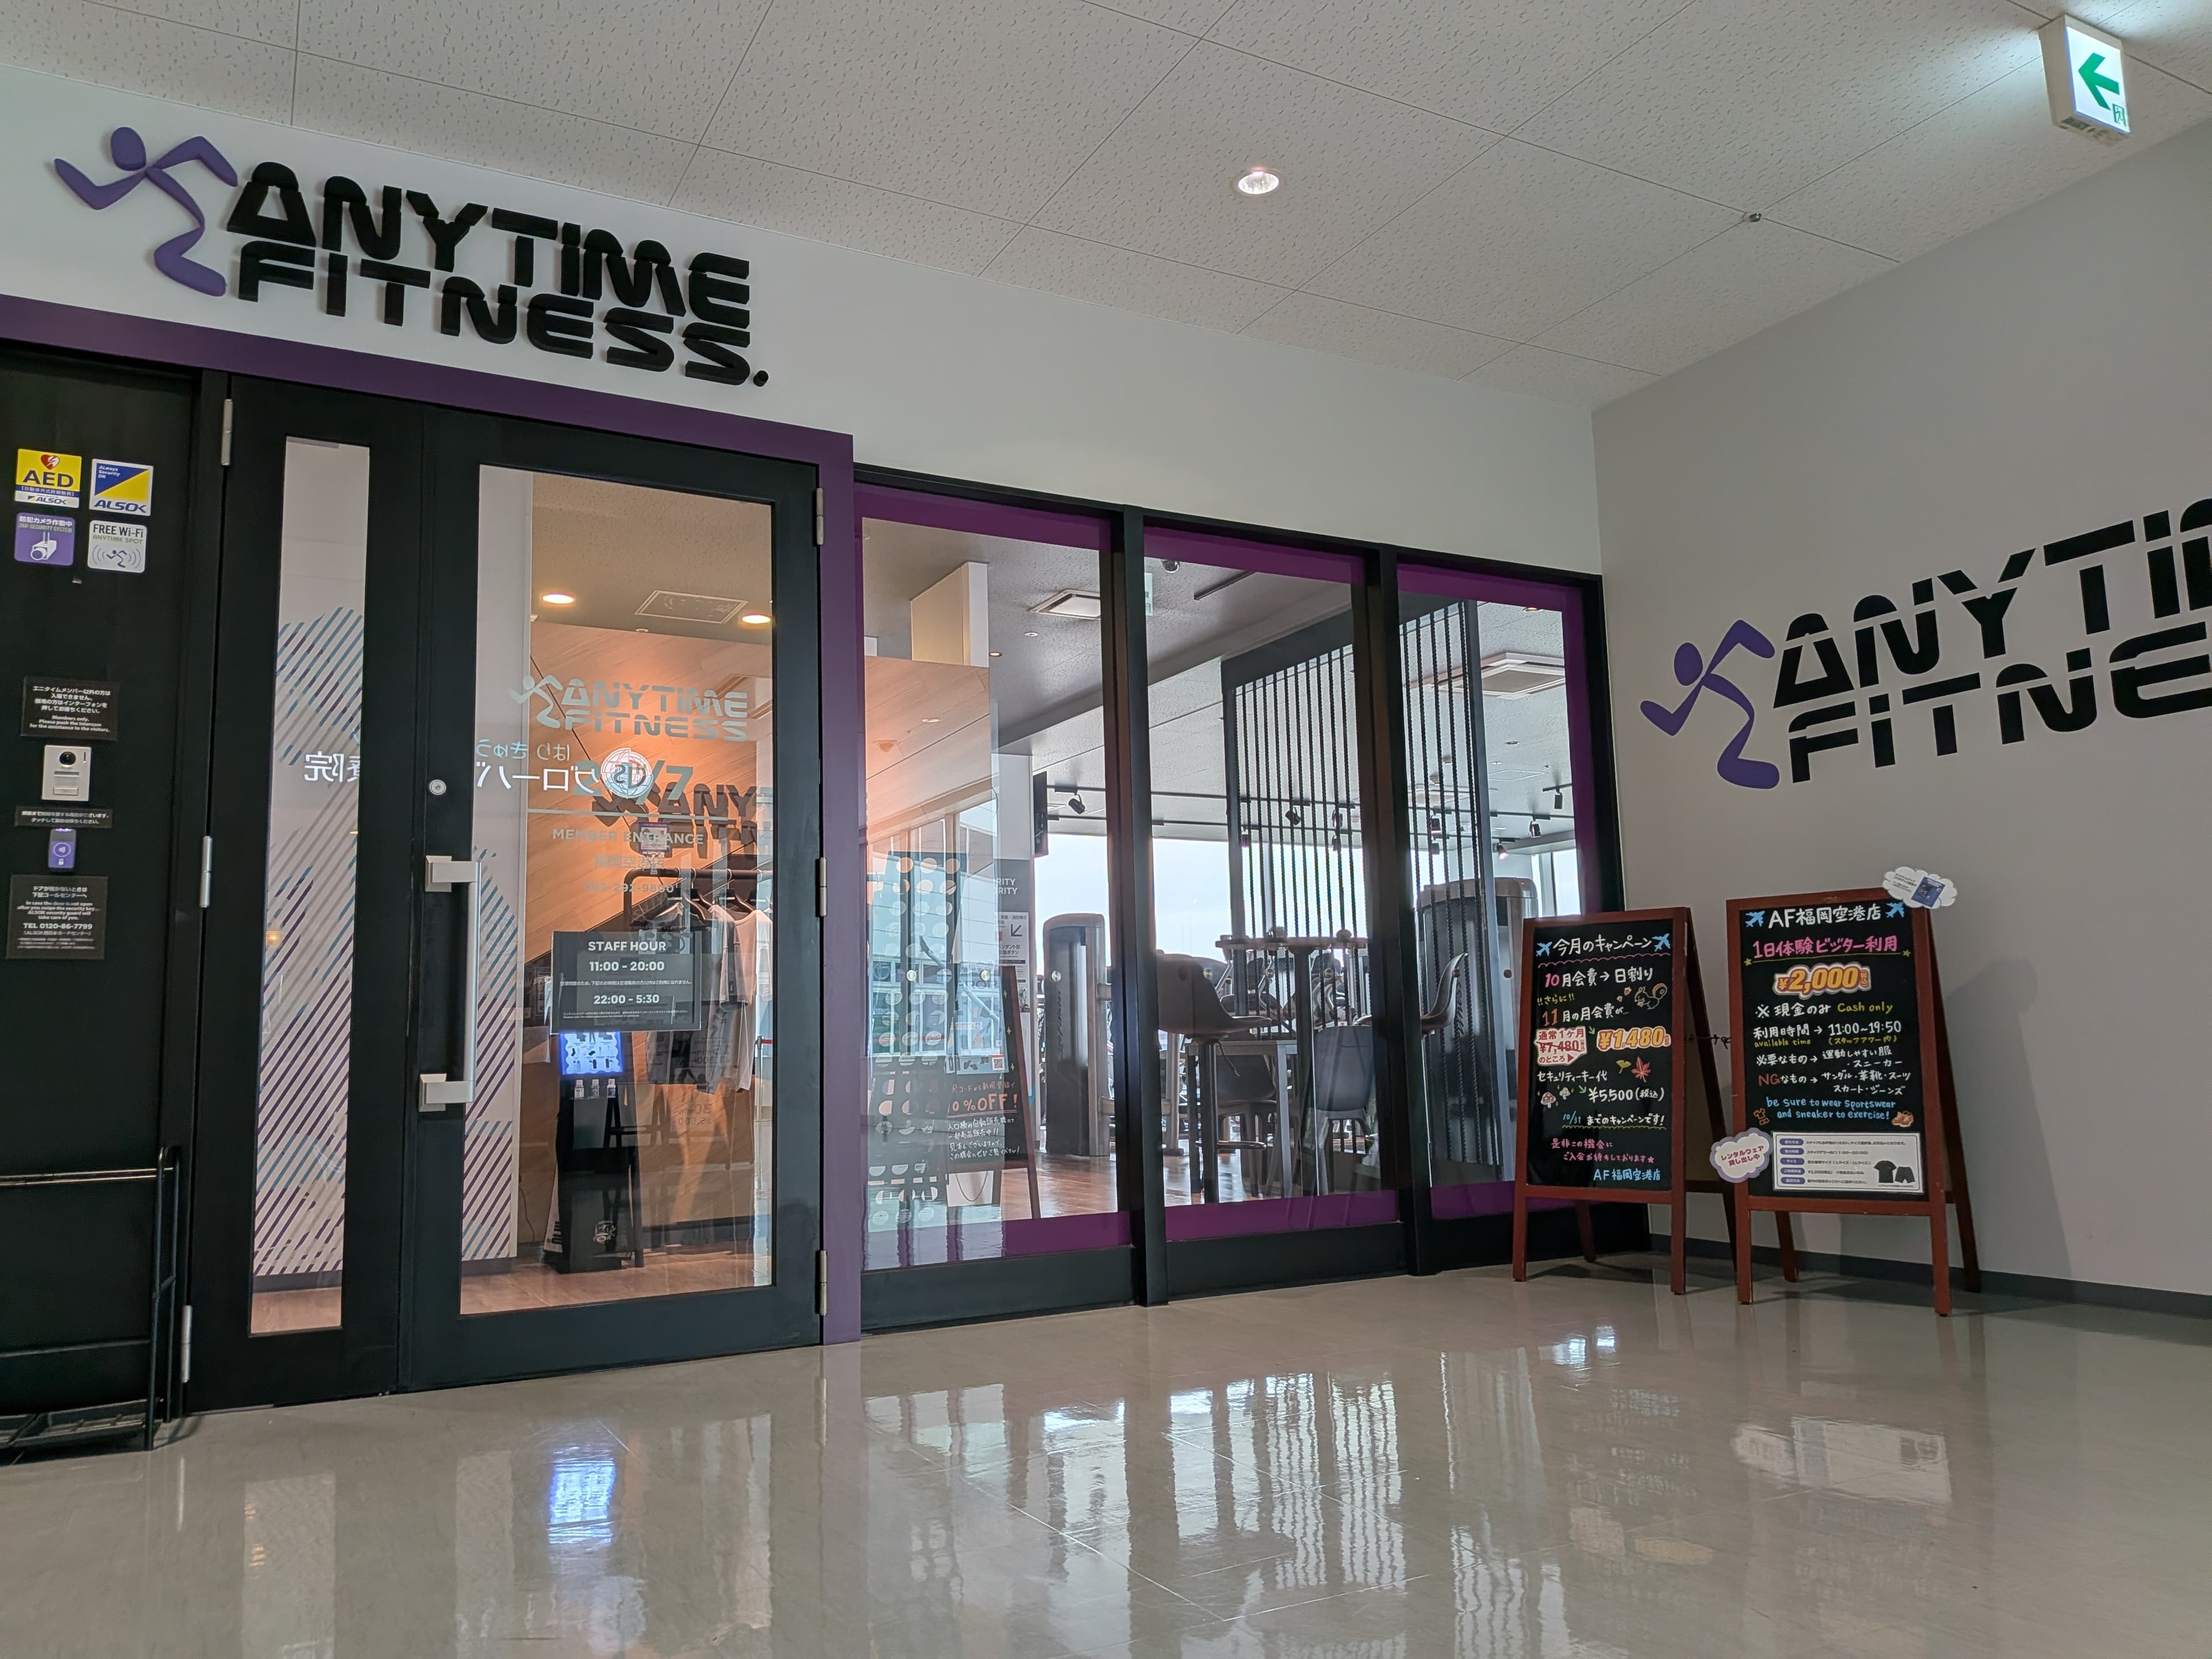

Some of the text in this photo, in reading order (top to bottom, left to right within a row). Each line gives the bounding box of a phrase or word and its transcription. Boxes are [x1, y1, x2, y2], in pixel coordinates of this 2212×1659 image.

[227, 161, 750, 328] ANYTIME
[22, 469, 74, 487] AED
[36, 497, 67, 505] ALSOK
[94, 499, 147, 513] ALSOK
[19, 516, 73, 527] 防犯カメラ作動中
[93, 524, 144, 538] FREE Wi-Fi
[93, 534, 123, 542] ANYTIME
[561, 679, 748, 718] ANYTIME
[565, 709, 748, 743] FITNESS
[552, 830, 618, 841] MEMBER
[1768, 903, 1881, 929] AF福岡空港店
[588, 941, 666, 951] STAFF HOUR
[1553, 934, 1652, 956] 今月のキャンペーン
[1752, 935, 1898, 959] 1日体験ビジター利用
[589, 961, 619, 972] 11:00
[630, 961, 665, 971] 20:00
[1544, 966, 1653, 988] 10月会費 日割り
[1778, 967, 1859, 996] ¥2,000
[593, 995, 626, 1005] 22:00
[636, 994, 660, 1004] 5:30
[1837, 1001, 1893, 1014] Cash only
[1753, 1023, 1810, 1040] 利用時間
[1598, 1027, 1664, 1050] ¥1,480
[1754, 1037, 1789, 1047] available
[1539, 1040, 1580, 1055] ¥7,480
[1539, 1055, 1565, 1063] のところ
[1756, 1046, 1893, 1066] 必要なもの 運動しやすい服
[1537, 1070, 1608, 1082] セキュリティーキー代
[1758, 1073, 1807, 1086] NGなもの
[1766, 1096, 1779, 1108] be
[1809, 1099, 1820, 1107] to
[1821, 1099, 1842, 1108] wear
[1562, 1111, 1581, 1124] 10/31
[1777, 1108, 1890, 1120] and sneaker to exercise!
[1551, 1138, 1613, 1149] 是非この機会に
[1721, 1145, 1764, 1161] レンタルウェア
[1728, 1153, 1760, 1166] 貸し出し中
[1593, 1168, 1661, 1181] AF福岡空港店
